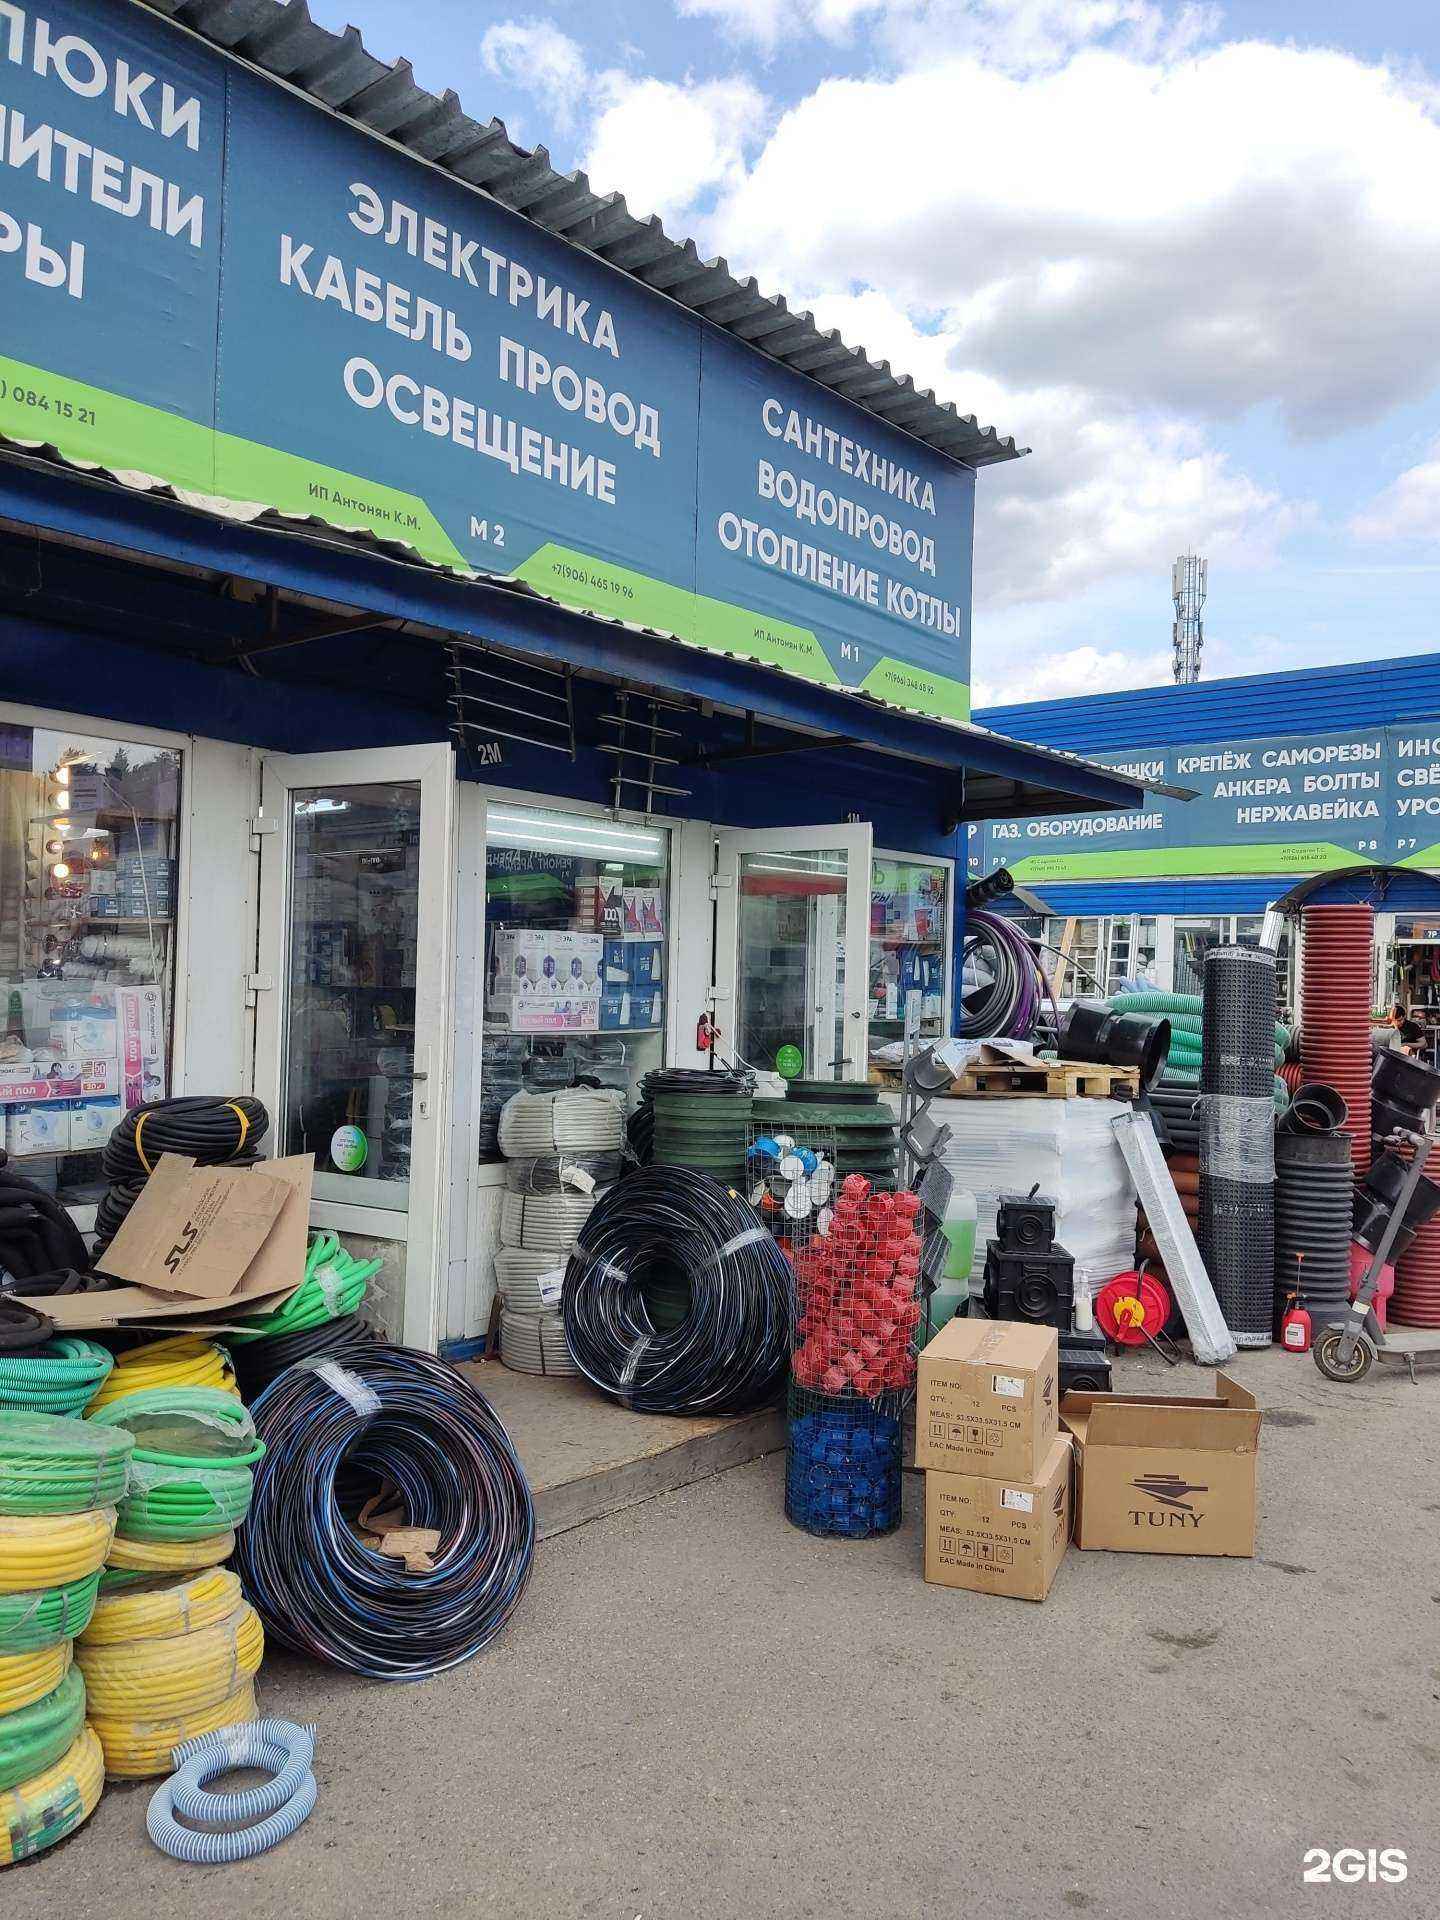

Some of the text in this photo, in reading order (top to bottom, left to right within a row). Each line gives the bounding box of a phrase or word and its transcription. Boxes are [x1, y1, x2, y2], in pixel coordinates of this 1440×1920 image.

[0, 104, 204, 248] ИТЕЛИ
[346, 182, 621, 359] ЭЛЕКТРИКА
[279, 233, 662, 458] КАБЕЛЬ ПРОВОД
[13, 386, 49, 411] 084
[55, 399, 73, 418] 15
[78, 407, 96, 426] 21
[343, 356, 617, 505] ОСВЕЩЕНИЕ
[762, 398, 937, 516] САНТЕХНИКА
[309, 482, 422, 531] ИП Антонян К.М.
[757, 459, 936, 577] ВОДОПРОВОД
[470, 515, 505, 547] М 2
[551, 562, 634, 600] +7(906) 465 19 96
[717, 511, 961, 638] ОТОПЛЕНИЕ КОТЛЫ
[753, 628, 765, 640] ИП
[841, 641, 860, 662] М 1
[1176, 742, 1381, 774] КРЕПЁЖ САМОРЕЗЫ
[1111, 760, 1164, 779] ЯНКИ
[1213, 771, 1380, 799] АНКЕРА БОЛТЫ
[1236, 798, 1380, 824] НЕРЖАВЕЙКА
[1396, 797, 1440, 817] УРО
[992, 813, 1163, 839] ГАЗ. ОБОРУДОВАНИЕ
[1369, 839, 1378, 850] 8
[1408, 838, 1417, 849] 7
[1000, 856, 1007, 866] 9
[930, 1379, 948, 1388] ITEM
[1001, 1404, 1017, 1412] PCS
[1009, 1421, 1021, 1429] CM
[929, 1441, 944, 1449] EAC
[945, 1443, 964, 1452] Made
[973, 1447, 995, 1457] China
[940, 1493, 957, 1502] ITEM
[1011, 1520, 1027, 1529] PCS
[1127, 1510, 1206, 1528] TUNY
[1019, 1538, 1031, 1546] CM
[939, 1556, 955, 1565] EAC
[956, 1559, 975, 1568] Made
[984, 1563, 1006, 1574] China
